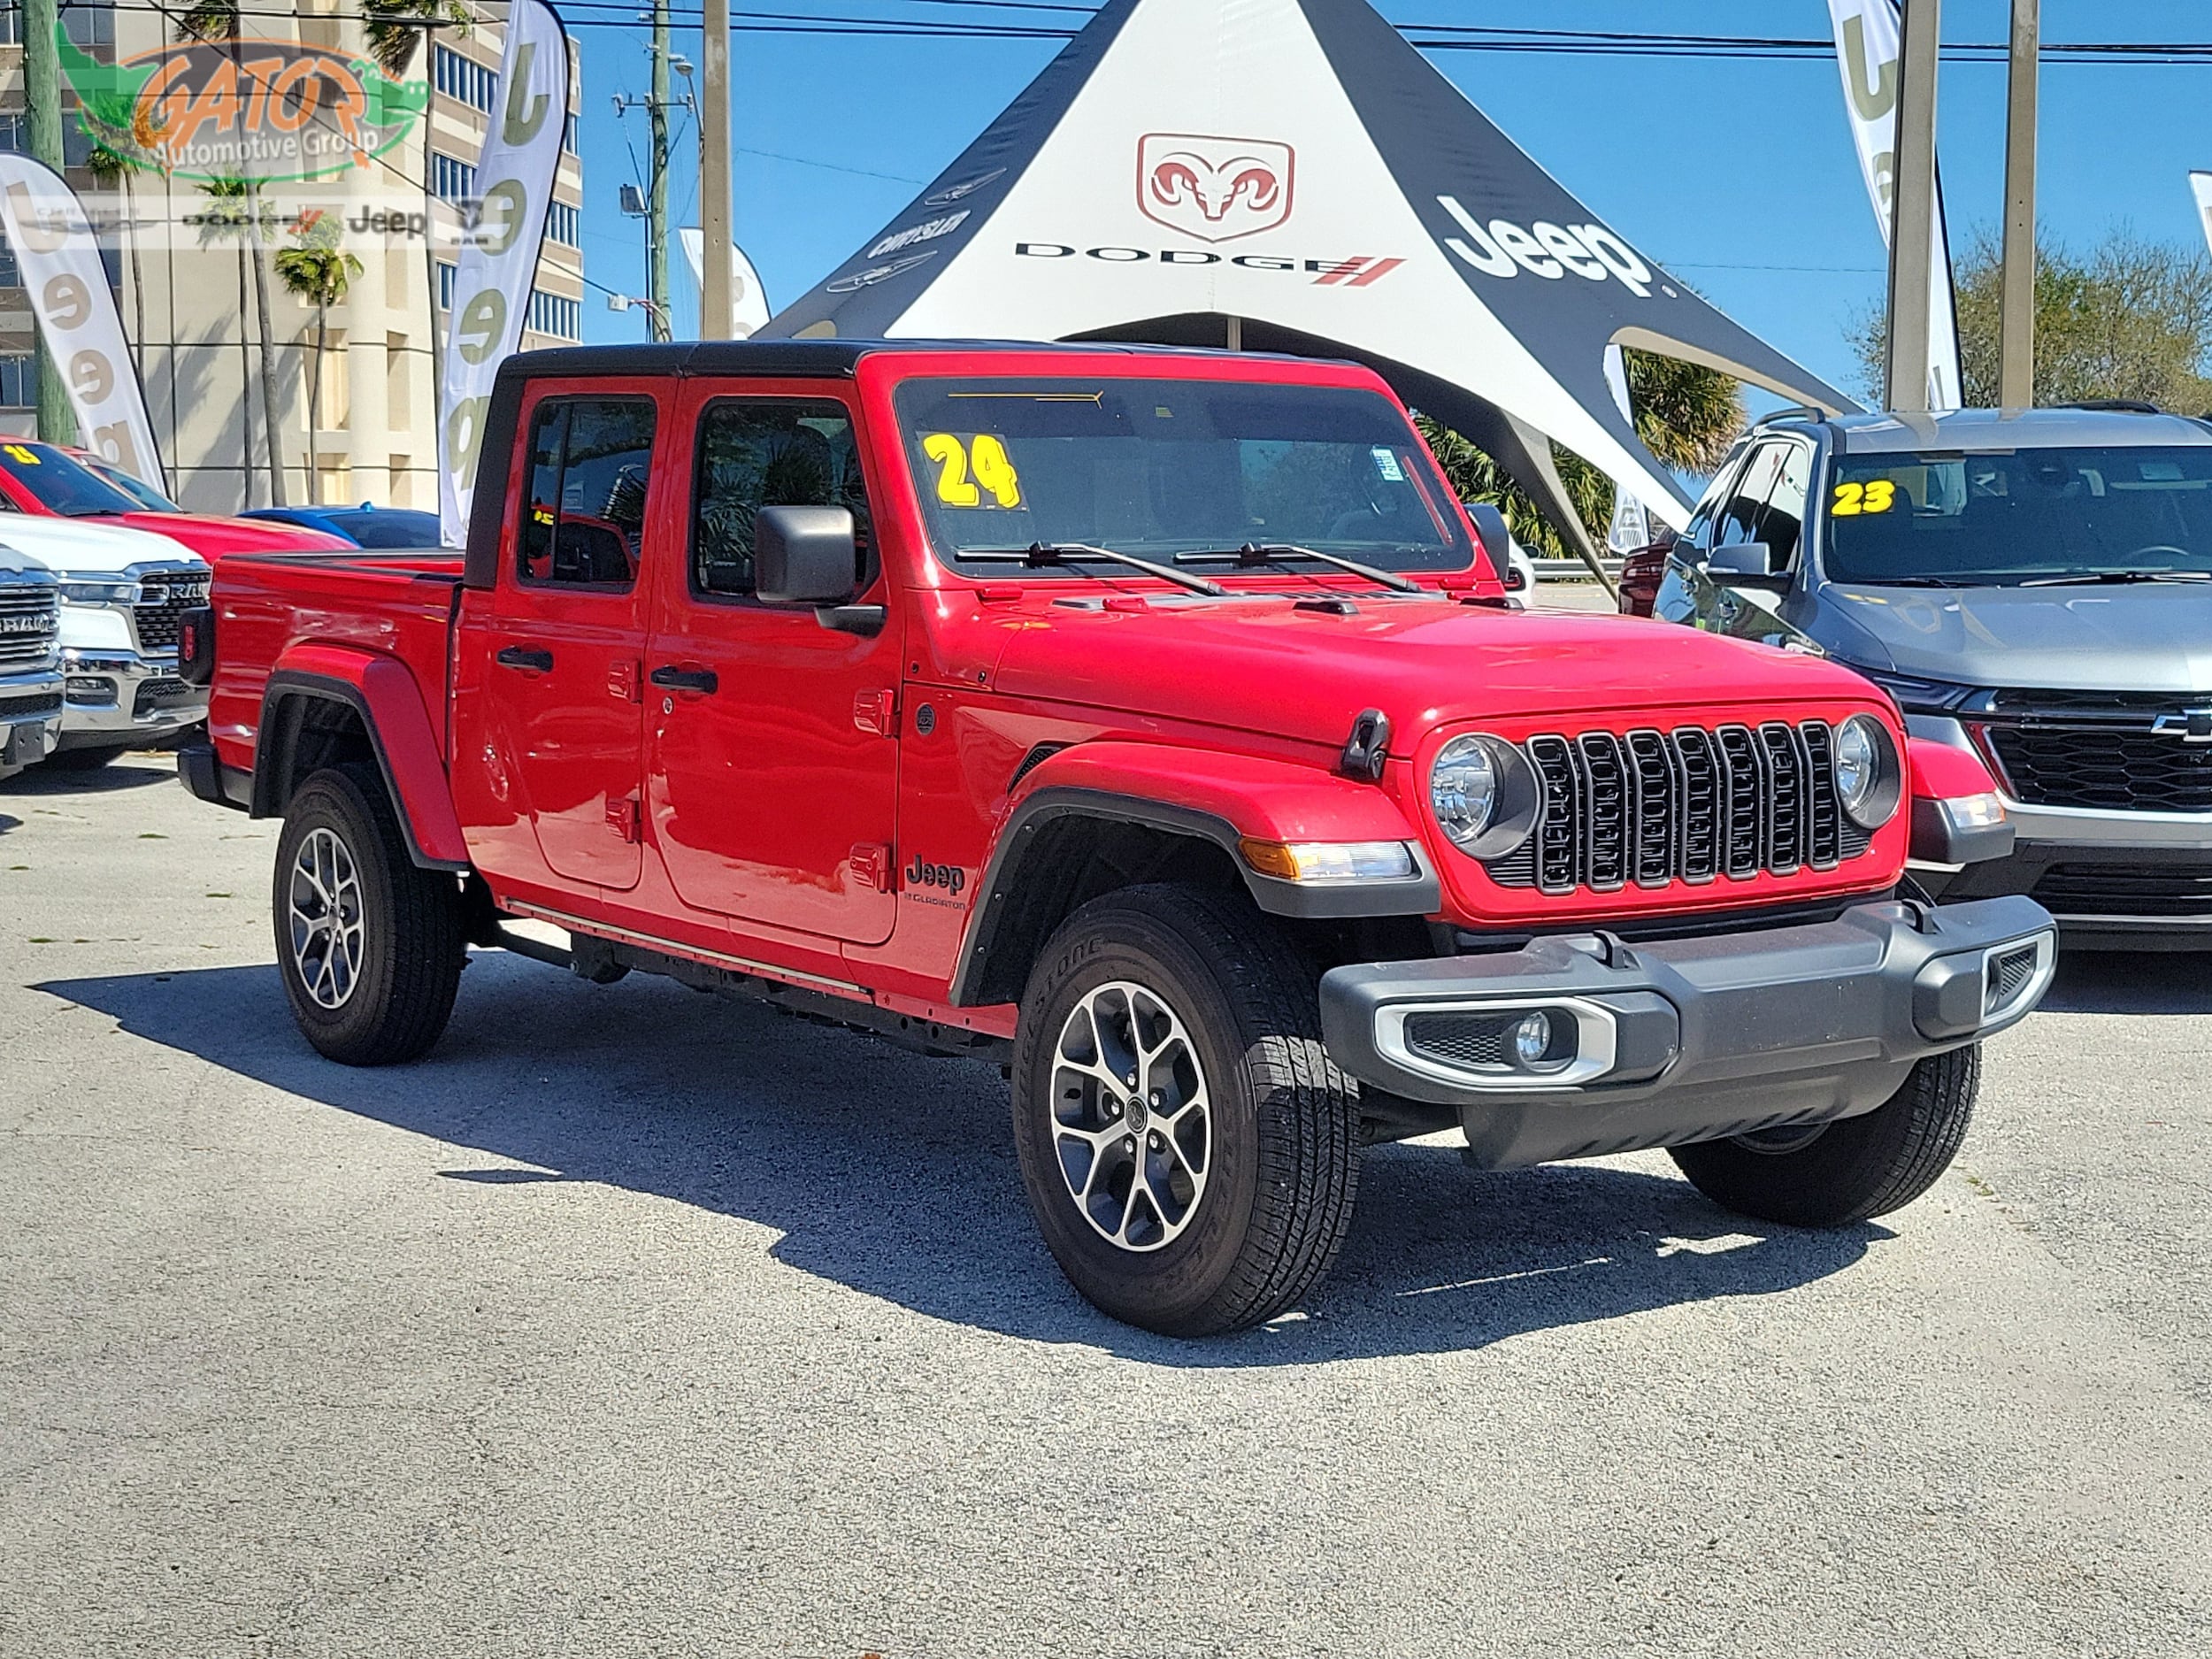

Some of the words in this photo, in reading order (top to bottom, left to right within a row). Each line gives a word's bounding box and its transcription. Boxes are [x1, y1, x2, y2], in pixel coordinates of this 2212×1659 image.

[867, 210, 972, 259] CHRYSLER
[1436, 196, 1652, 298] Jeep
[1016, 242, 1363, 276] DODGE
[922, 433, 1021, 509] 24
[1831, 480, 1895, 517] 23
[906, 854, 965, 896] Jeep
